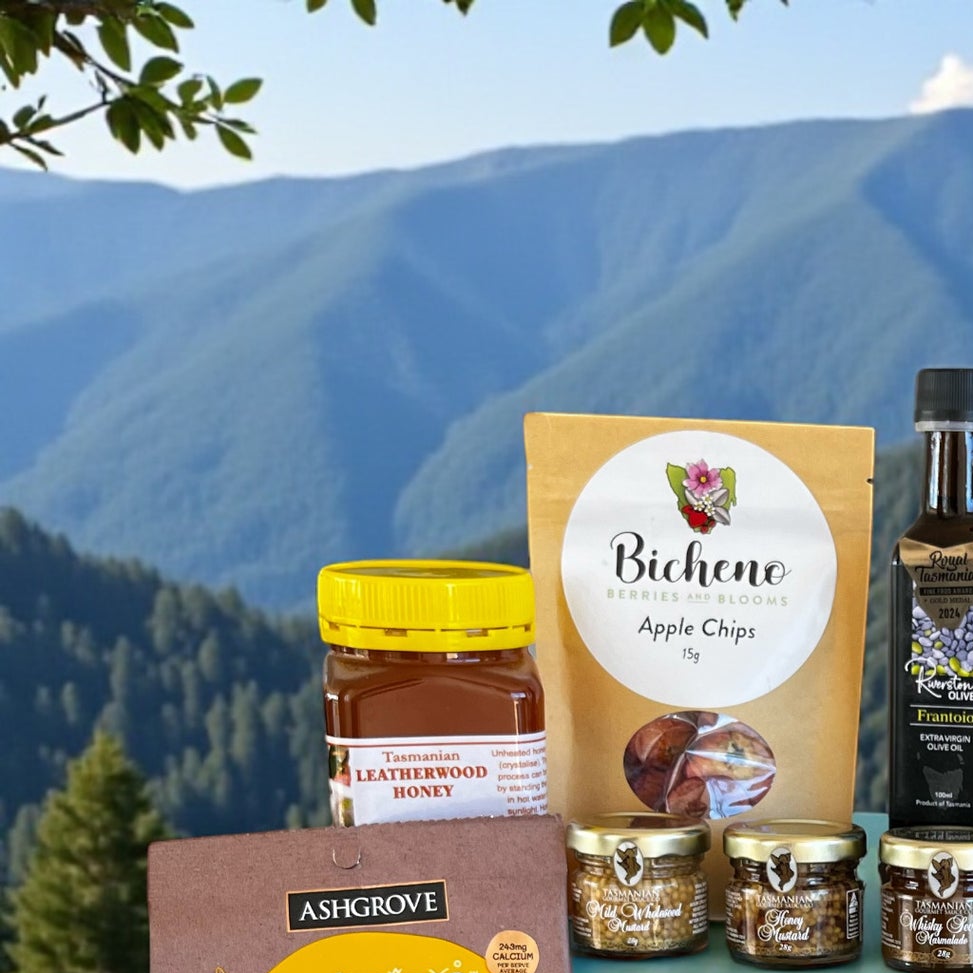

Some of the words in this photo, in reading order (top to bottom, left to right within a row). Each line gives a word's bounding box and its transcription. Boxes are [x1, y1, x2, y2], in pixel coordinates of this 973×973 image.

[610, 531, 792, 587] Bicheno
[929, 550, 968, 571] Royal
[607, 588, 679, 602] BERRIES
[688, 592, 711, 600] AND
[718, 594, 788, 606] BLOOMS
[938, 608, 960, 618] 2024
[638, 616, 694, 642] Apple
[702, 618, 756, 645] Chips
[682, 648, 700, 664] 15g
[920, 734, 944, 742] EXTRA
[944, 735, 970, 743] VIRGIN
[491, 748, 531, 757] Unheated
[926, 743, 949, 751] OLIVE
[950, 744, 964, 752] OIL
[382, 750, 460, 763] Tasmanian
[356, 765, 488, 782] LEATHERWOOD
[498, 773, 530, 782] process
[393, 784, 454, 799] HONEY
[496, 785, 506, 794] by
[509, 784, 540, 792] standing
[946, 800, 970, 808] Tasmania
[602, 888, 660, 898] TASMANIAN
[756, 894, 814, 903] TASMANIAN
[299, 890, 438, 922] ASHGROVE
[916, 900, 972, 910] TASMANIAN
[608, 918, 650, 932] Mustard
[765, 908, 804, 930] Honey
[900, 911, 943, 936] Whisky
[758, 923, 810, 942] Mustard
[916, 930, 968, 946] Marmalade
[499, 943, 527, 952] 243mg
[492, 952, 534, 960] CALCIUM
